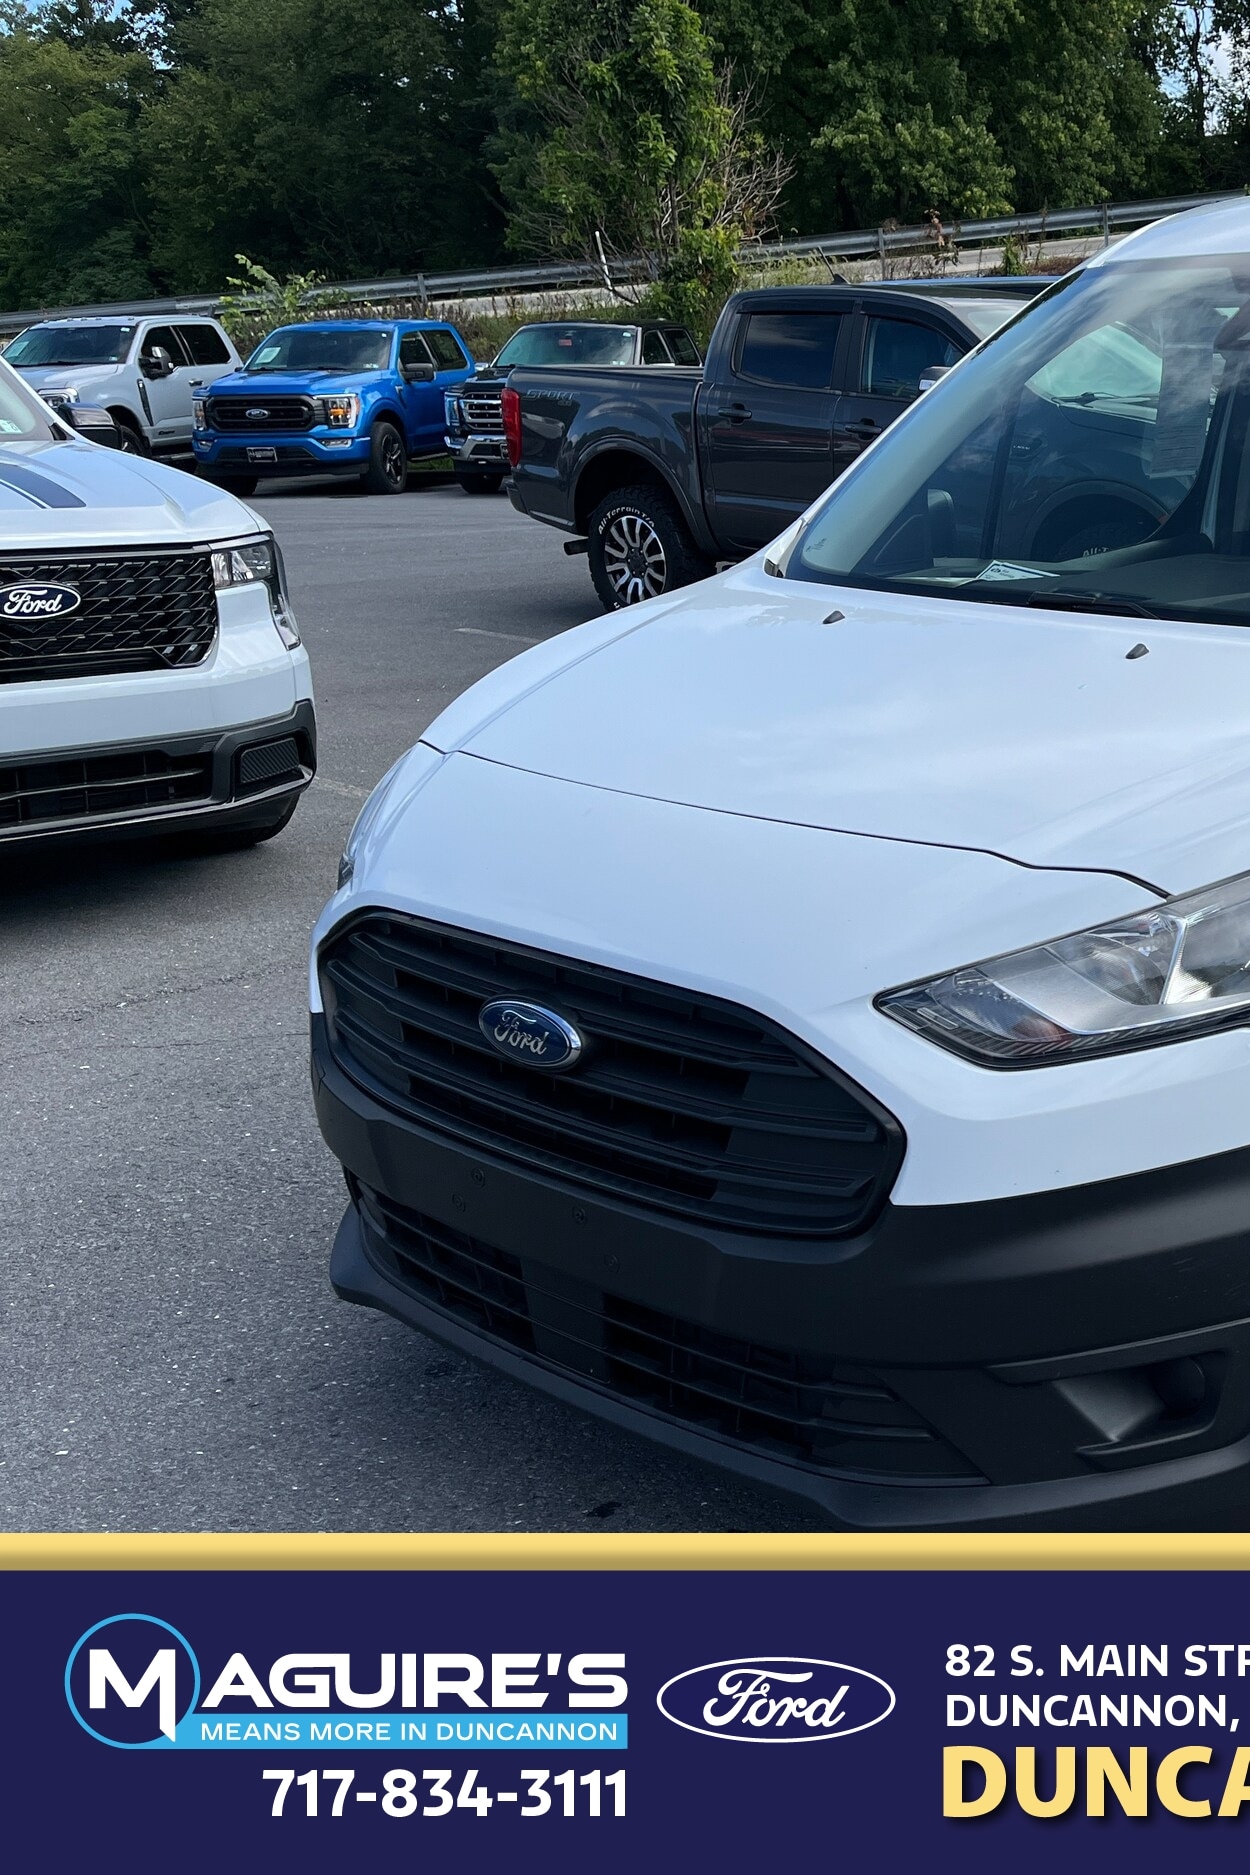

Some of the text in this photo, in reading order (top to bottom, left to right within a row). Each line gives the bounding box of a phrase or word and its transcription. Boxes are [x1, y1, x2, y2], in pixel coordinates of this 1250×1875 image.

[525, 388, 577, 400] SPORT
[598, 506, 640, 534] All-Terrain
[3, 589, 63, 614] Ford
[494, 1009, 550, 1055] Ford
